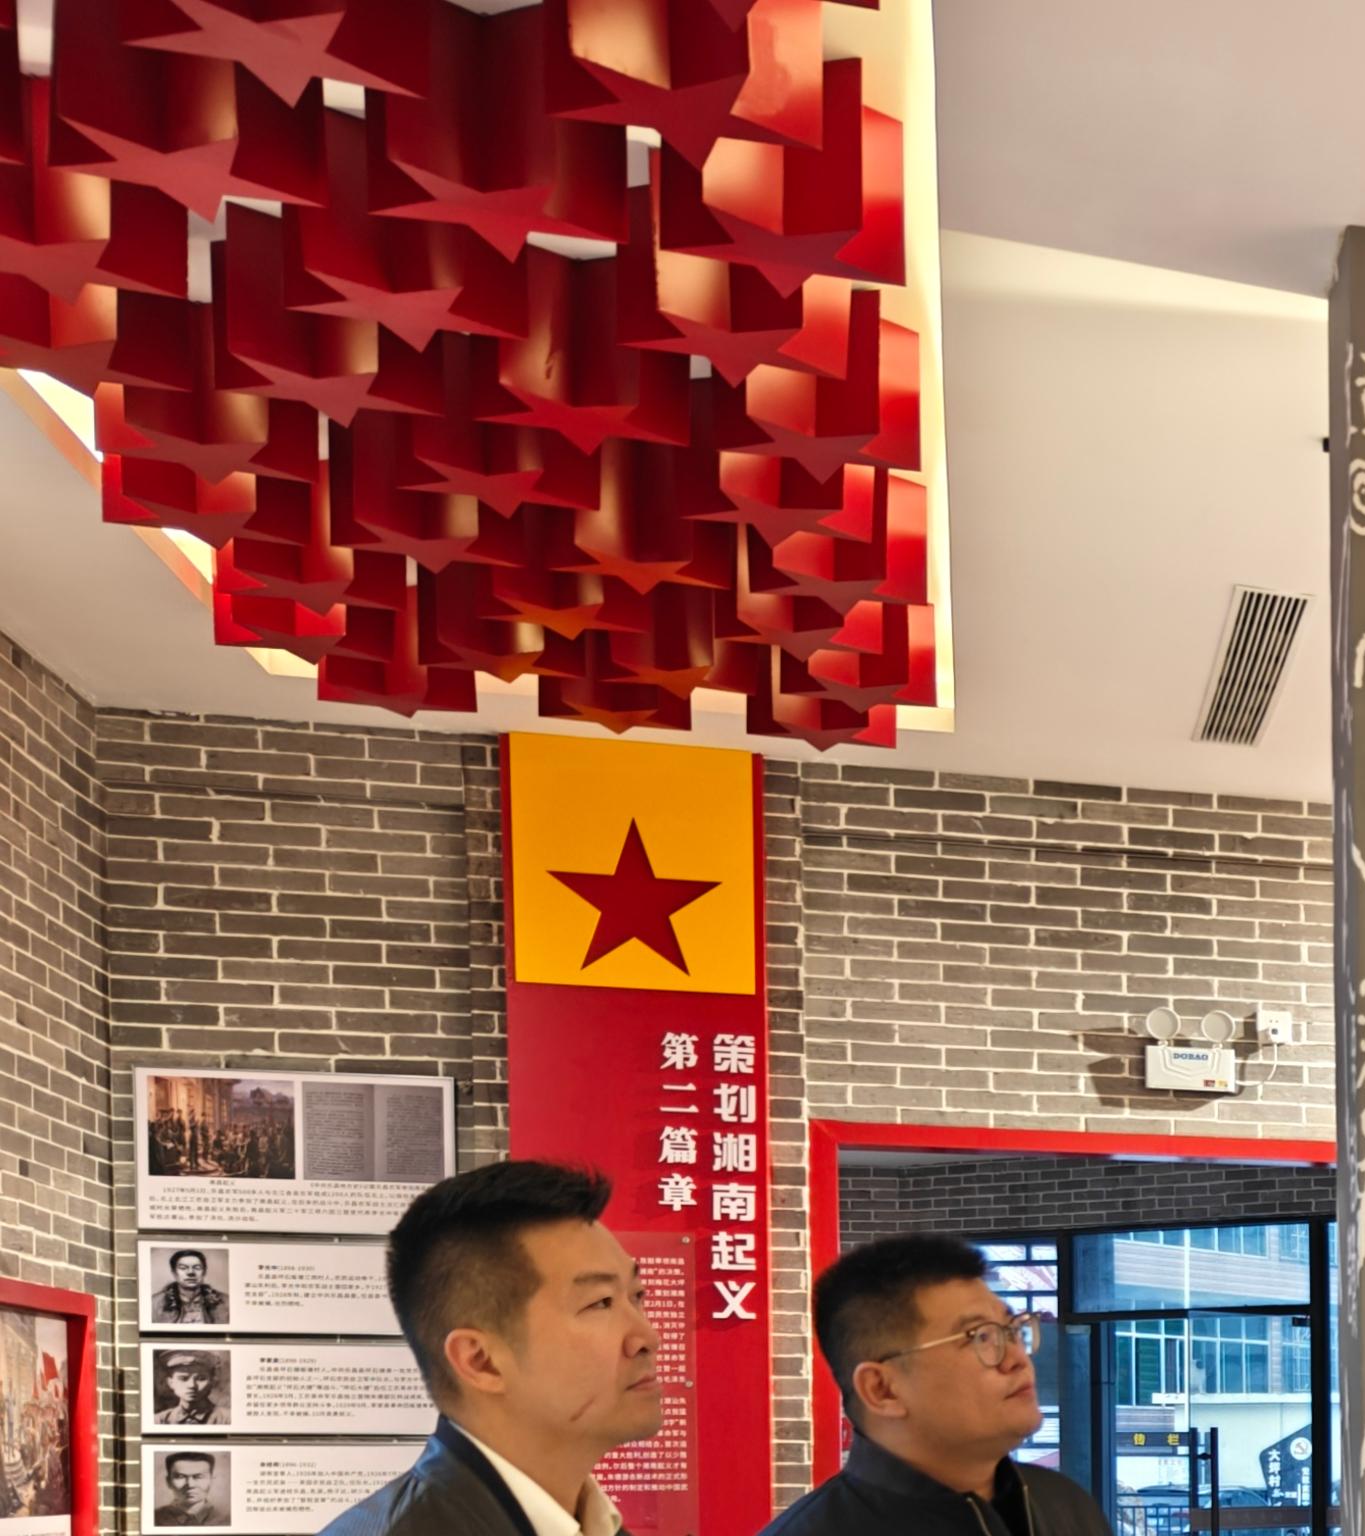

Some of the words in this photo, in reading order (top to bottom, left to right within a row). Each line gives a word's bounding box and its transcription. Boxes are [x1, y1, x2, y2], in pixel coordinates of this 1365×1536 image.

[658, 1032, 699, 1211] 第二篇章
[711, 1033, 757, 1320] 策划湘南起义
